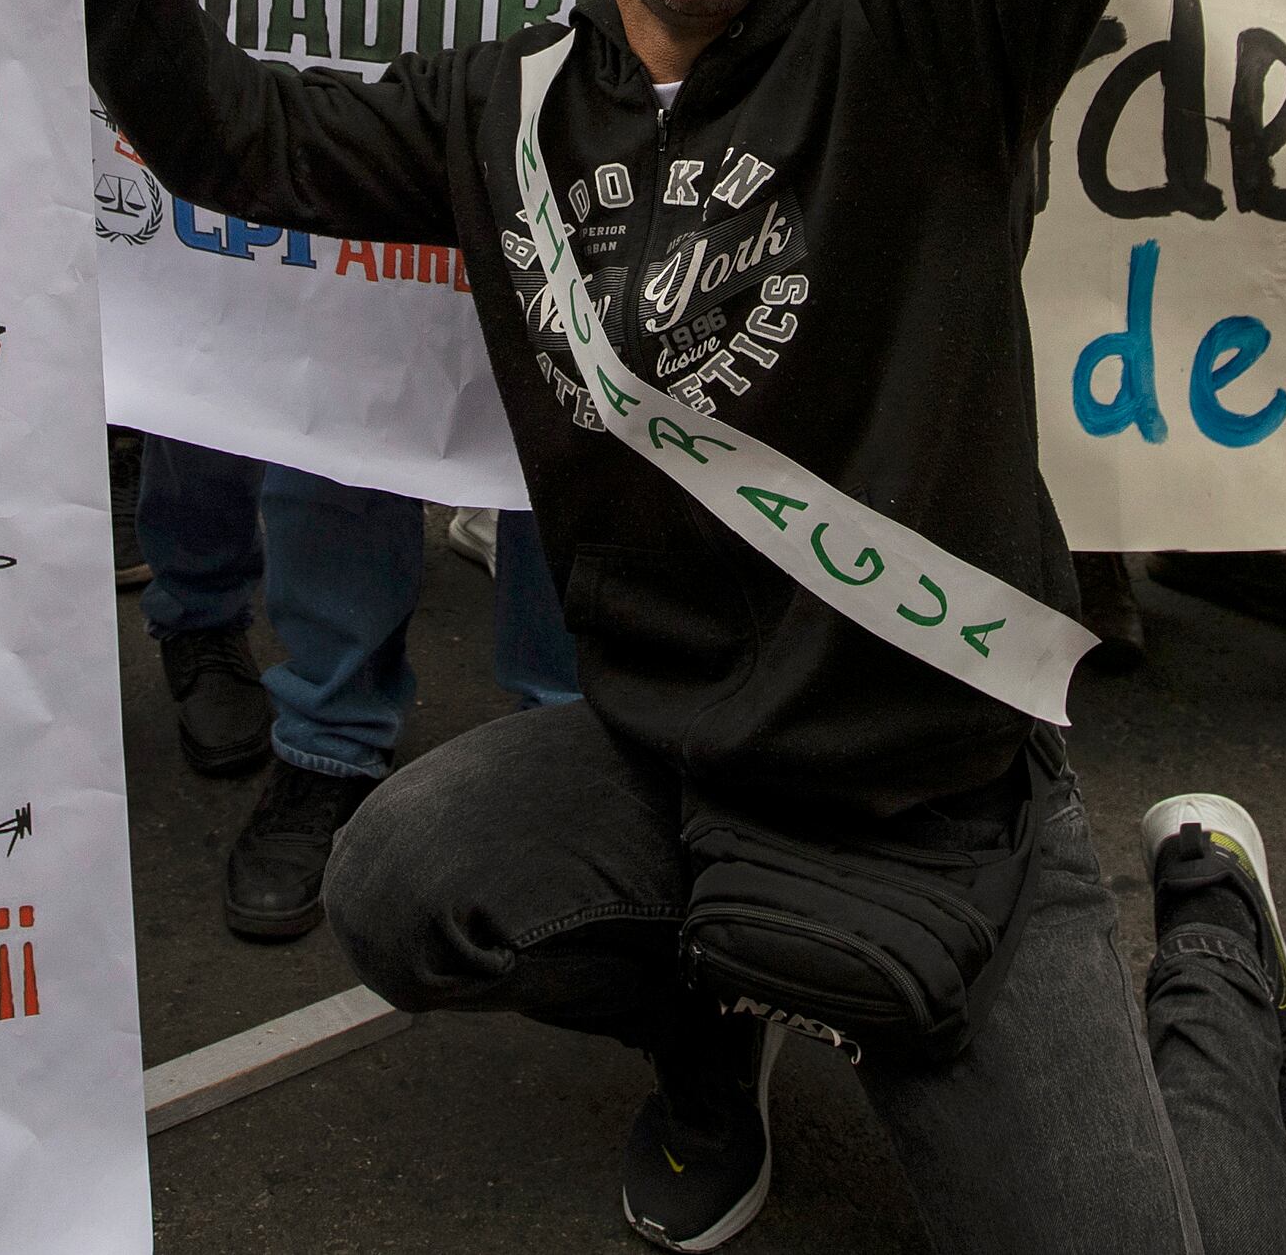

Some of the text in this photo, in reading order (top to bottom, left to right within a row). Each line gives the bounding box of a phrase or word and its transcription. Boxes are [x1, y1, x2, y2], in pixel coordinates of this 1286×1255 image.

[644, 200, 793, 333] York
[656, 335, 721, 379] lusive
[658, 306, 728, 358] 1996
[518, 108, 1007, 658] NICARAGUA
